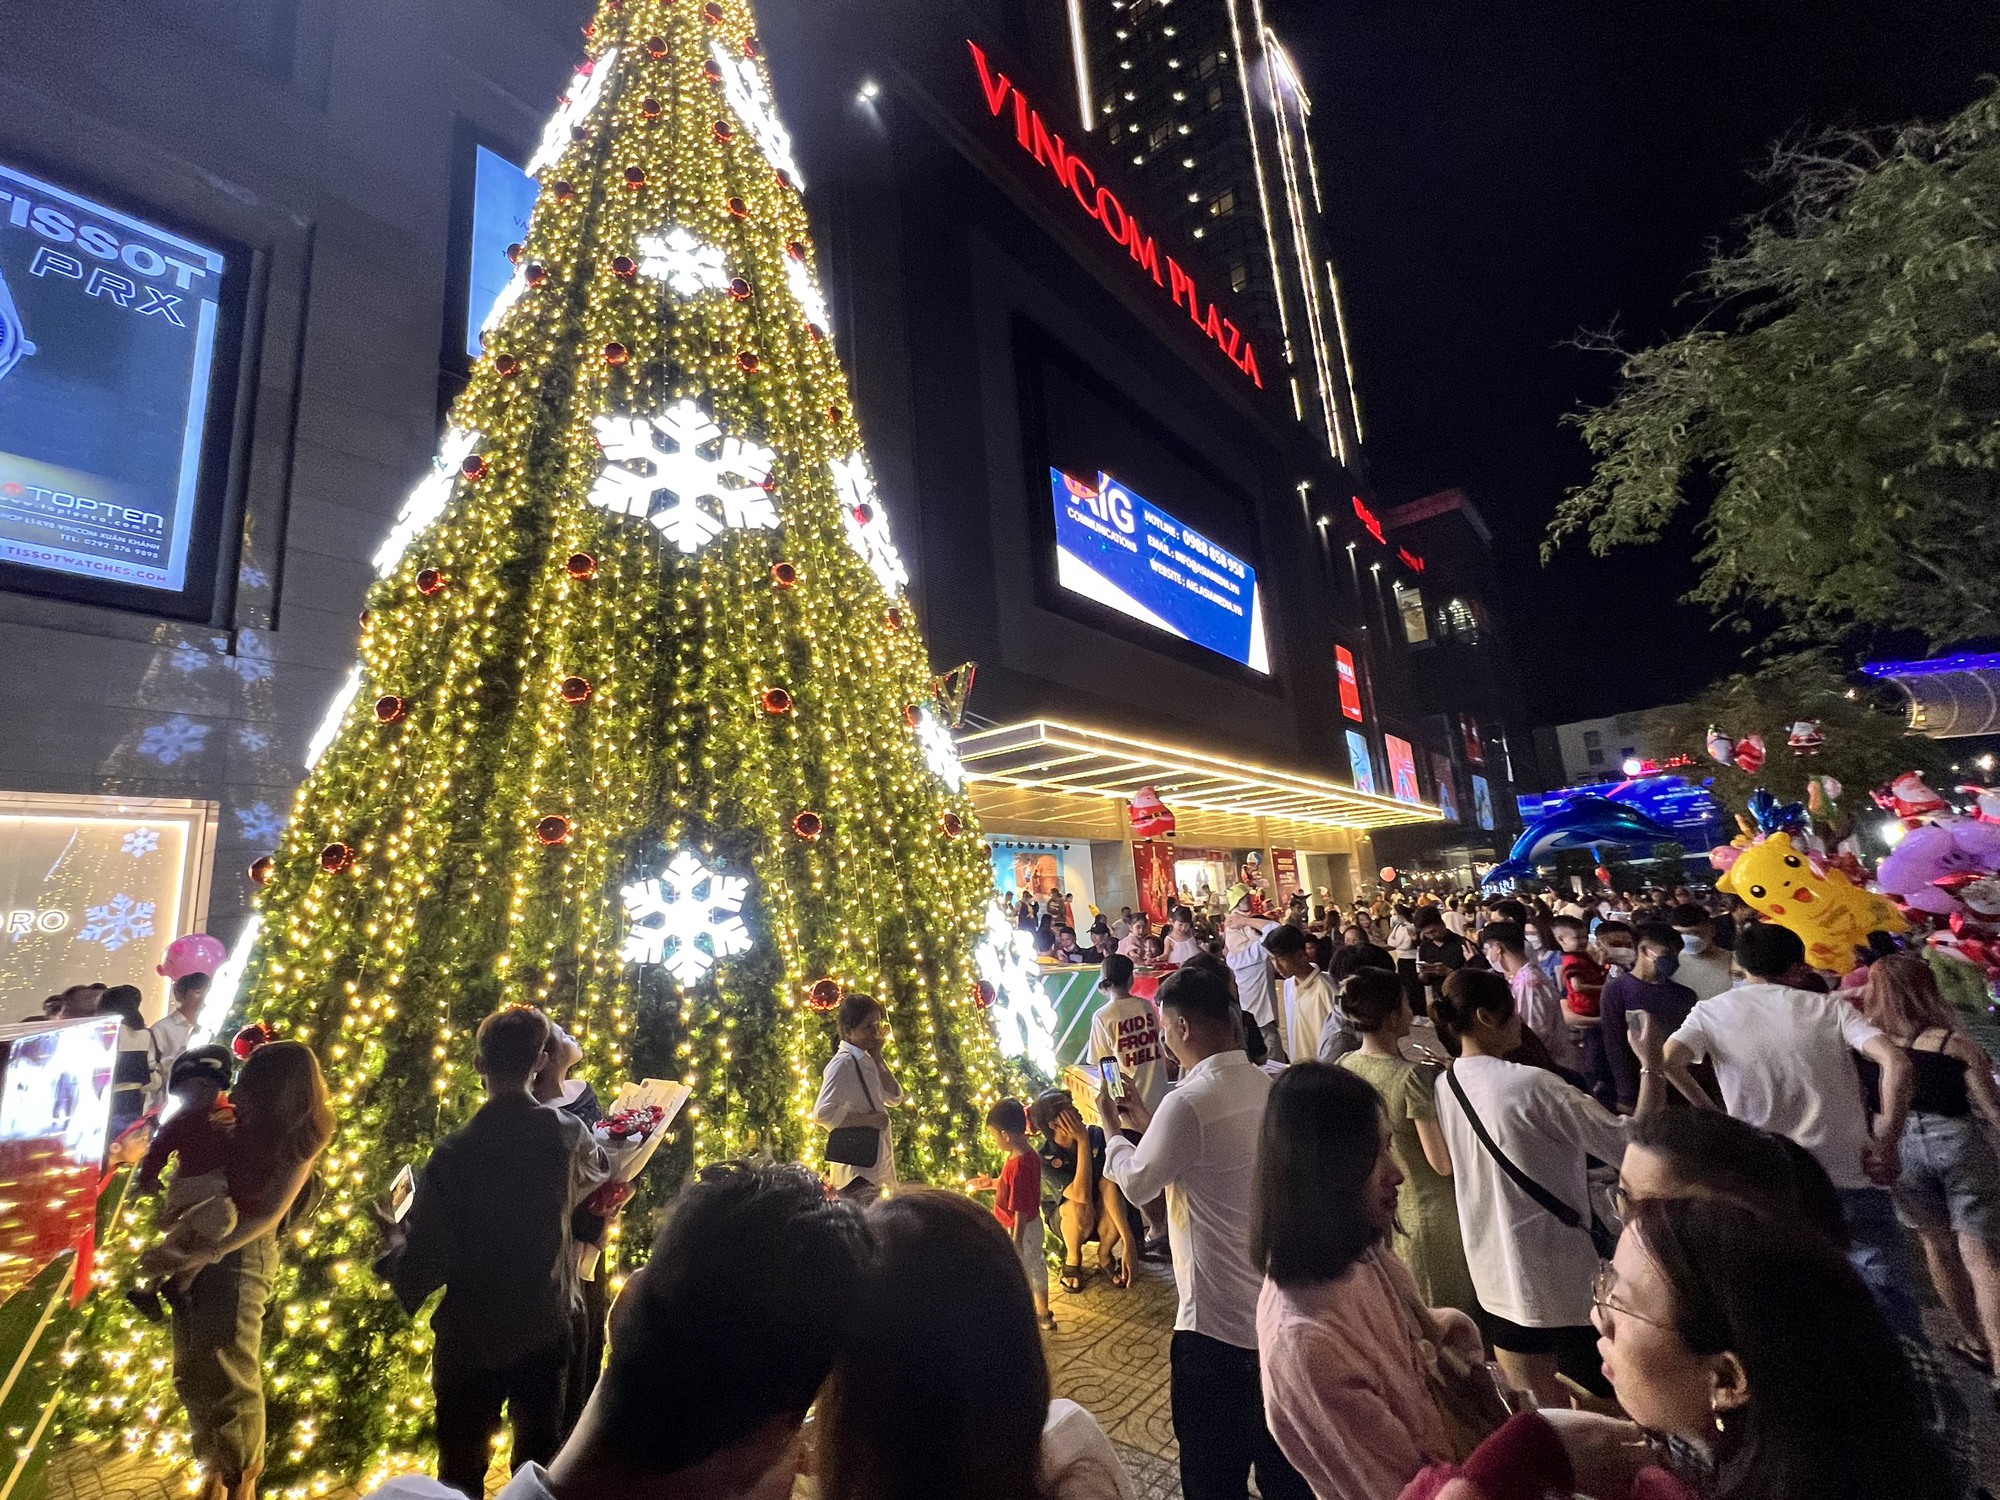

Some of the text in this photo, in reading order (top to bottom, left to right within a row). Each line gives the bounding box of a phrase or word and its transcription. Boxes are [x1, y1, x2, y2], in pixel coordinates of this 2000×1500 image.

[967, 38, 1263, 390] VINCOM PLAZA
[29, 246, 186, 328] PRX
[1067, 507, 1138, 553] COMMUNICATIONS
[0, 908, 69, 933] RO
[1118, 1012, 1155, 1036] KIDS
[1125, 1045, 1161, 1067] HELL
